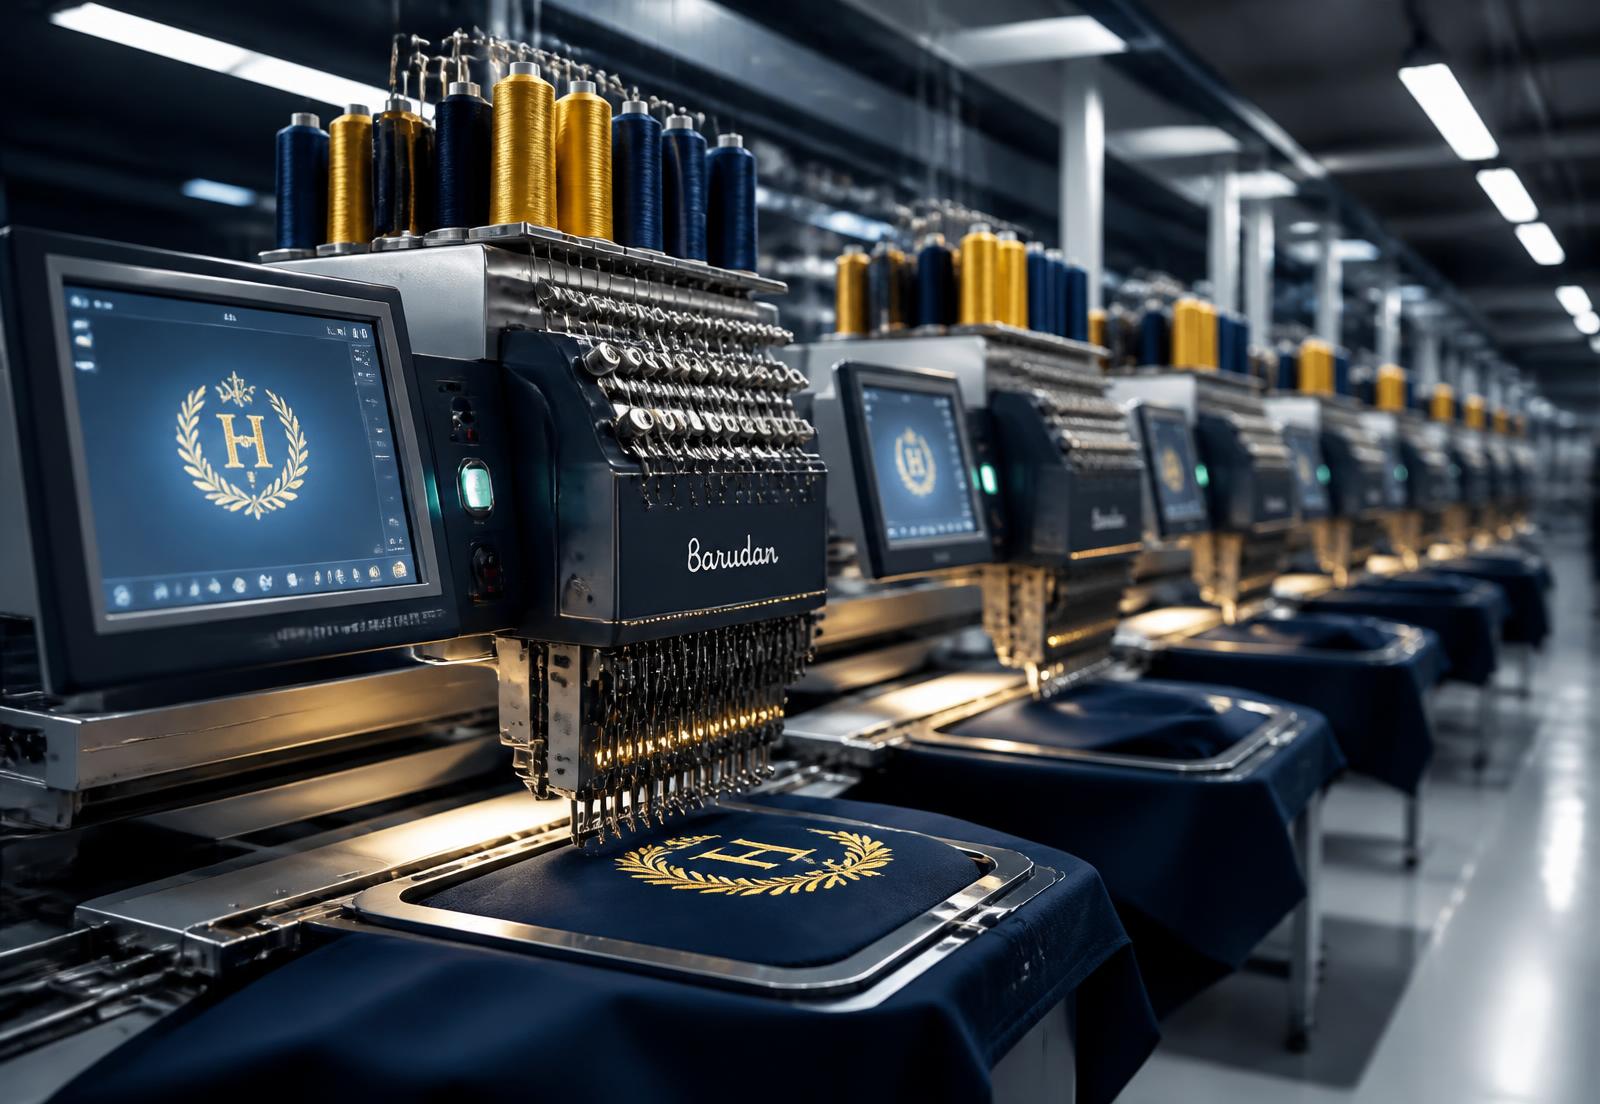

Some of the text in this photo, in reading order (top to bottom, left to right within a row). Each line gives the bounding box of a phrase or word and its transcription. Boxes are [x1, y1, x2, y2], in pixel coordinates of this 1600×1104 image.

[215, 413, 273, 468] H
[687, 534, 779, 573] Barudan
[688, 838, 817, 870] H
